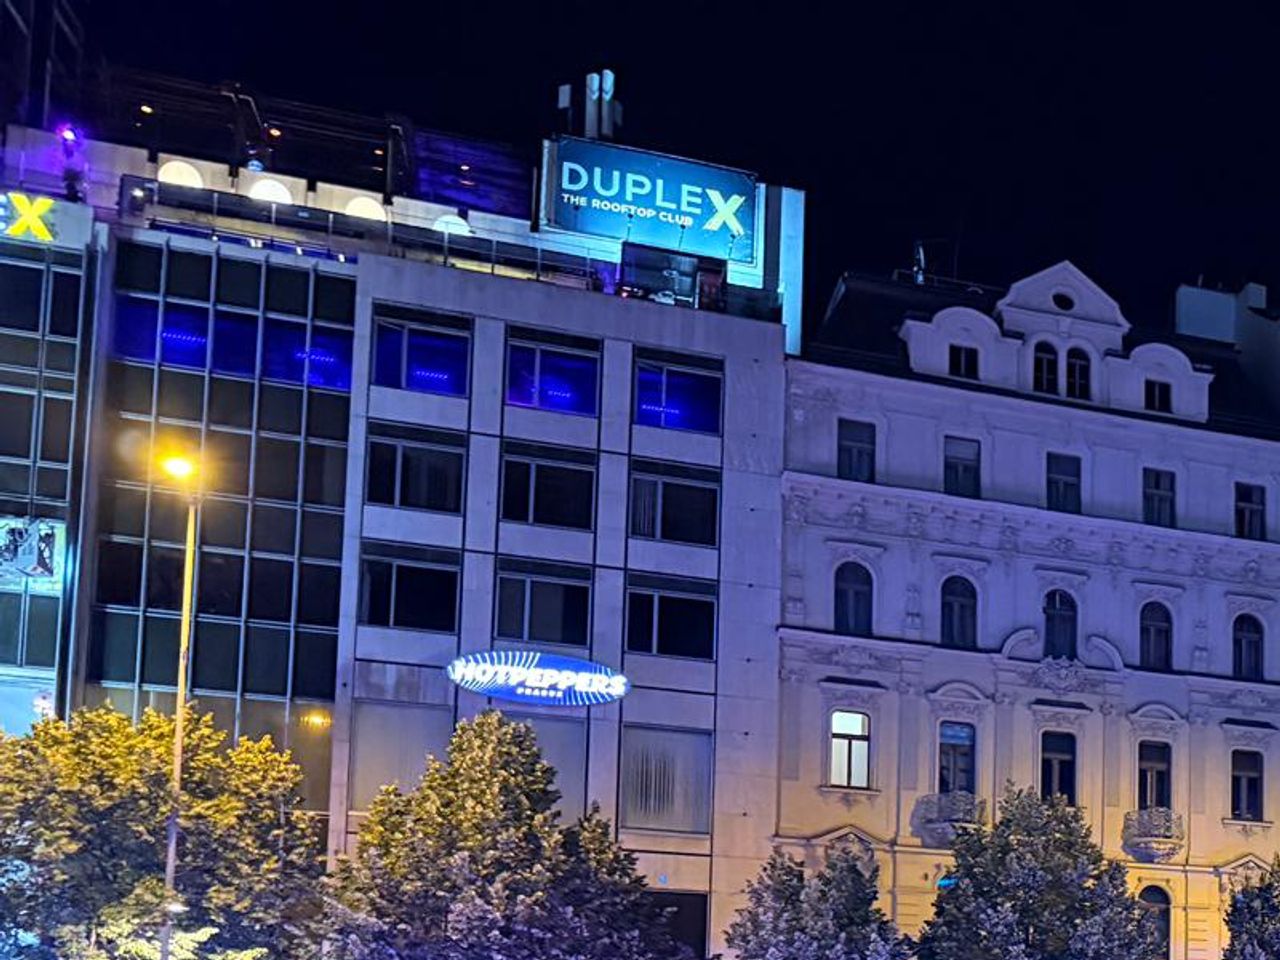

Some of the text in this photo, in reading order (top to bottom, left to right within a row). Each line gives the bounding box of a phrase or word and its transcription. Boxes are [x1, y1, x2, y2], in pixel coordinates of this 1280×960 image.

[561, 161, 746, 237] DUPLEX
[561, 193, 694, 228] THE ROOFTOP CLUB
